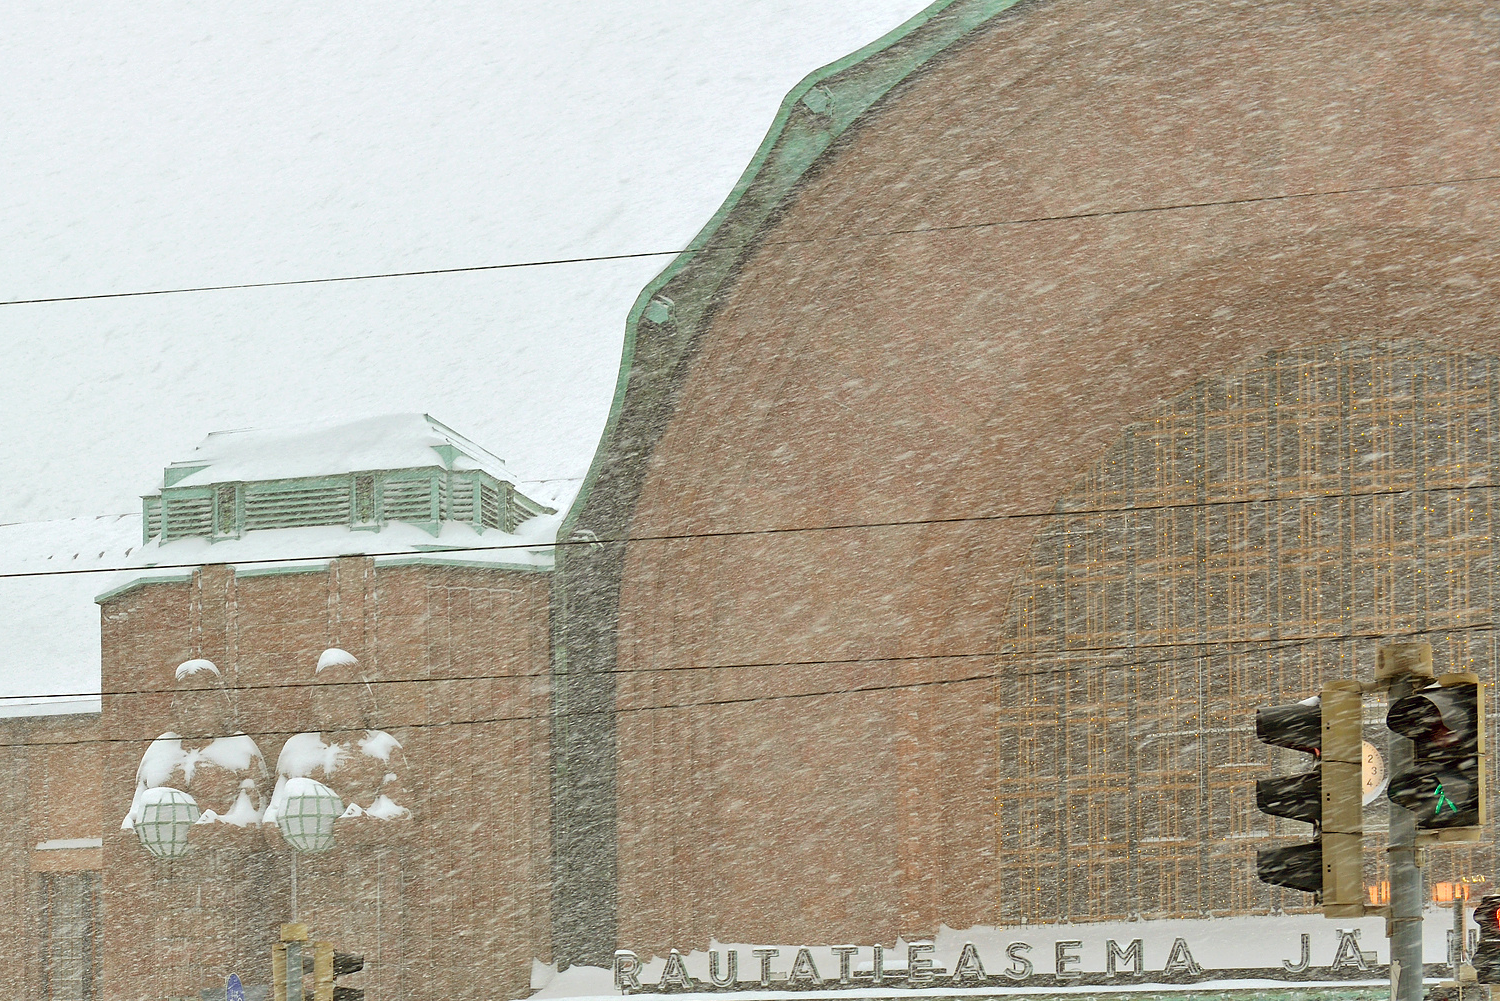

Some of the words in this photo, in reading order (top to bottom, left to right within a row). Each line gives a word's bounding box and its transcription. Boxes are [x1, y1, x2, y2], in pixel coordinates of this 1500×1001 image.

[1367, 754, 1373, 763] 2
[1371, 767, 1377, 775] 3
[1366, 778, 1372, 787] 4
[613, 935, 1203, 991] RAUTATIEASEMA
